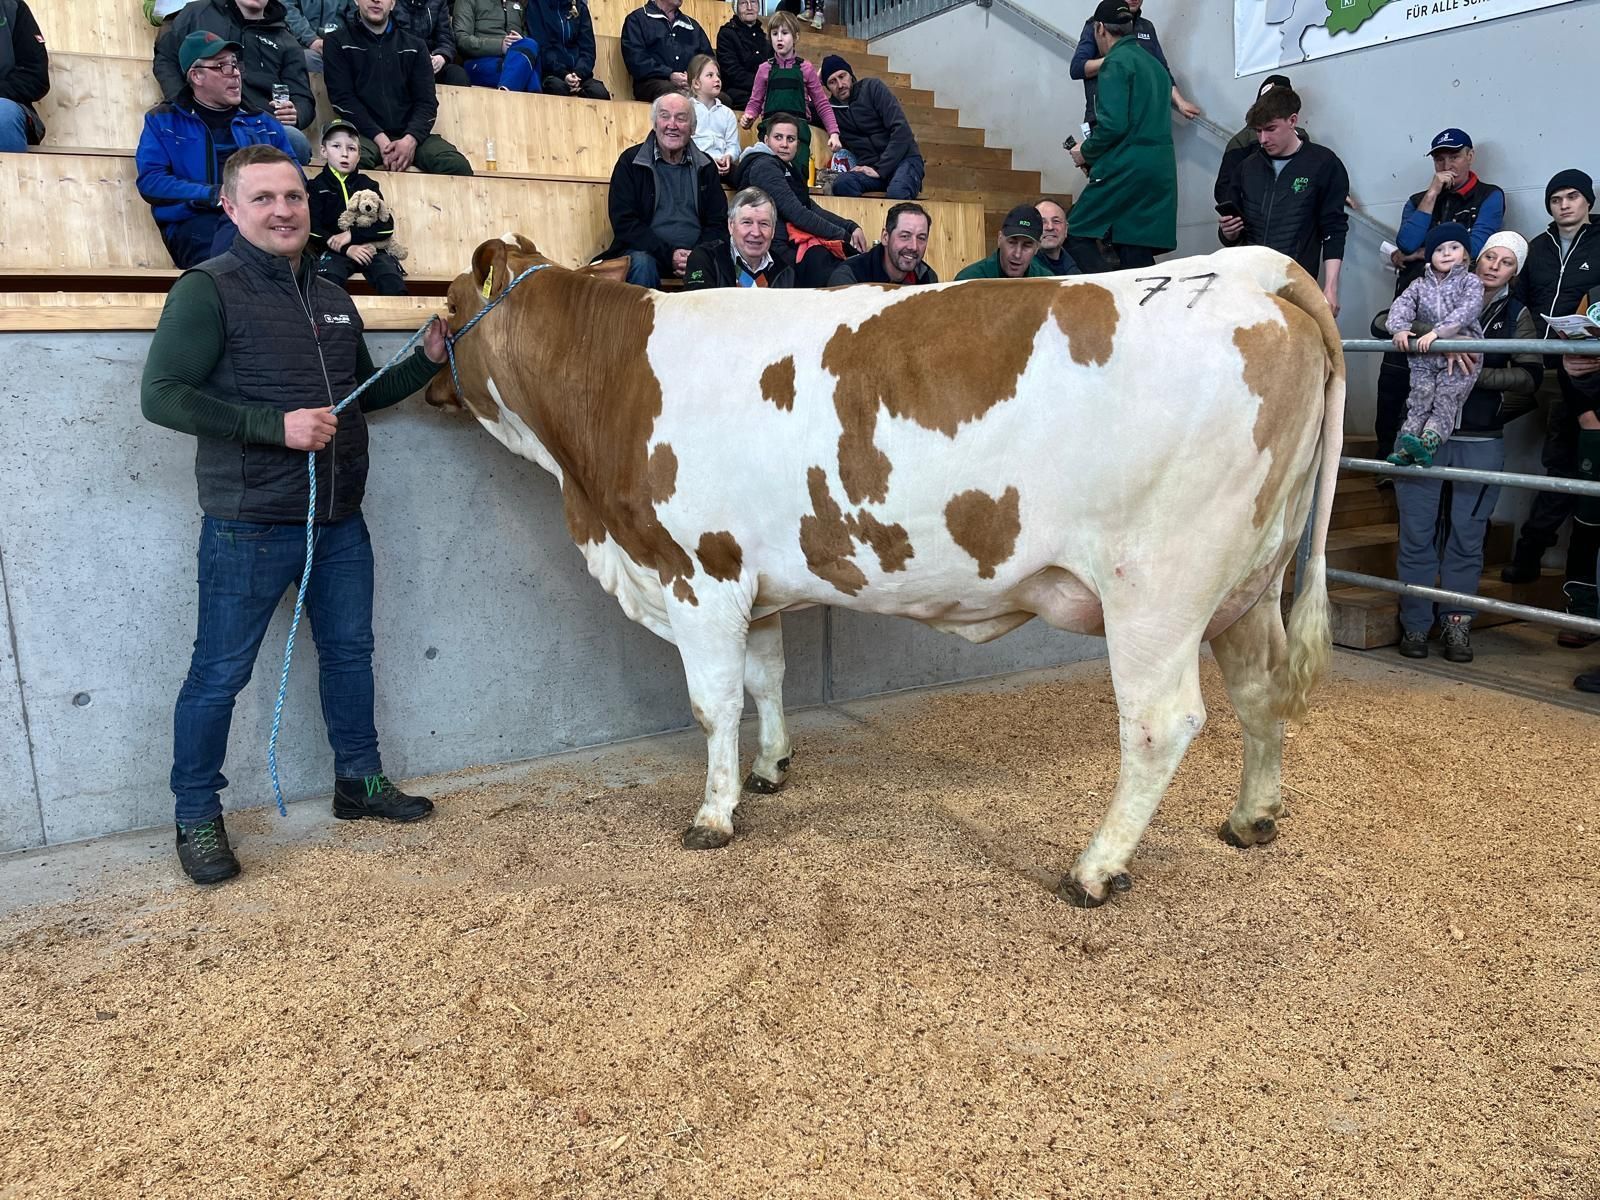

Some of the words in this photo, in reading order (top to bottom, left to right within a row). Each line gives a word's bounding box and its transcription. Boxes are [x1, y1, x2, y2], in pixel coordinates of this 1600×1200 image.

[1406, 4, 1428, 20] FÜR
[1431, 0, 1459, 14] ALLE
[1135, 272, 1219, 309] 77
